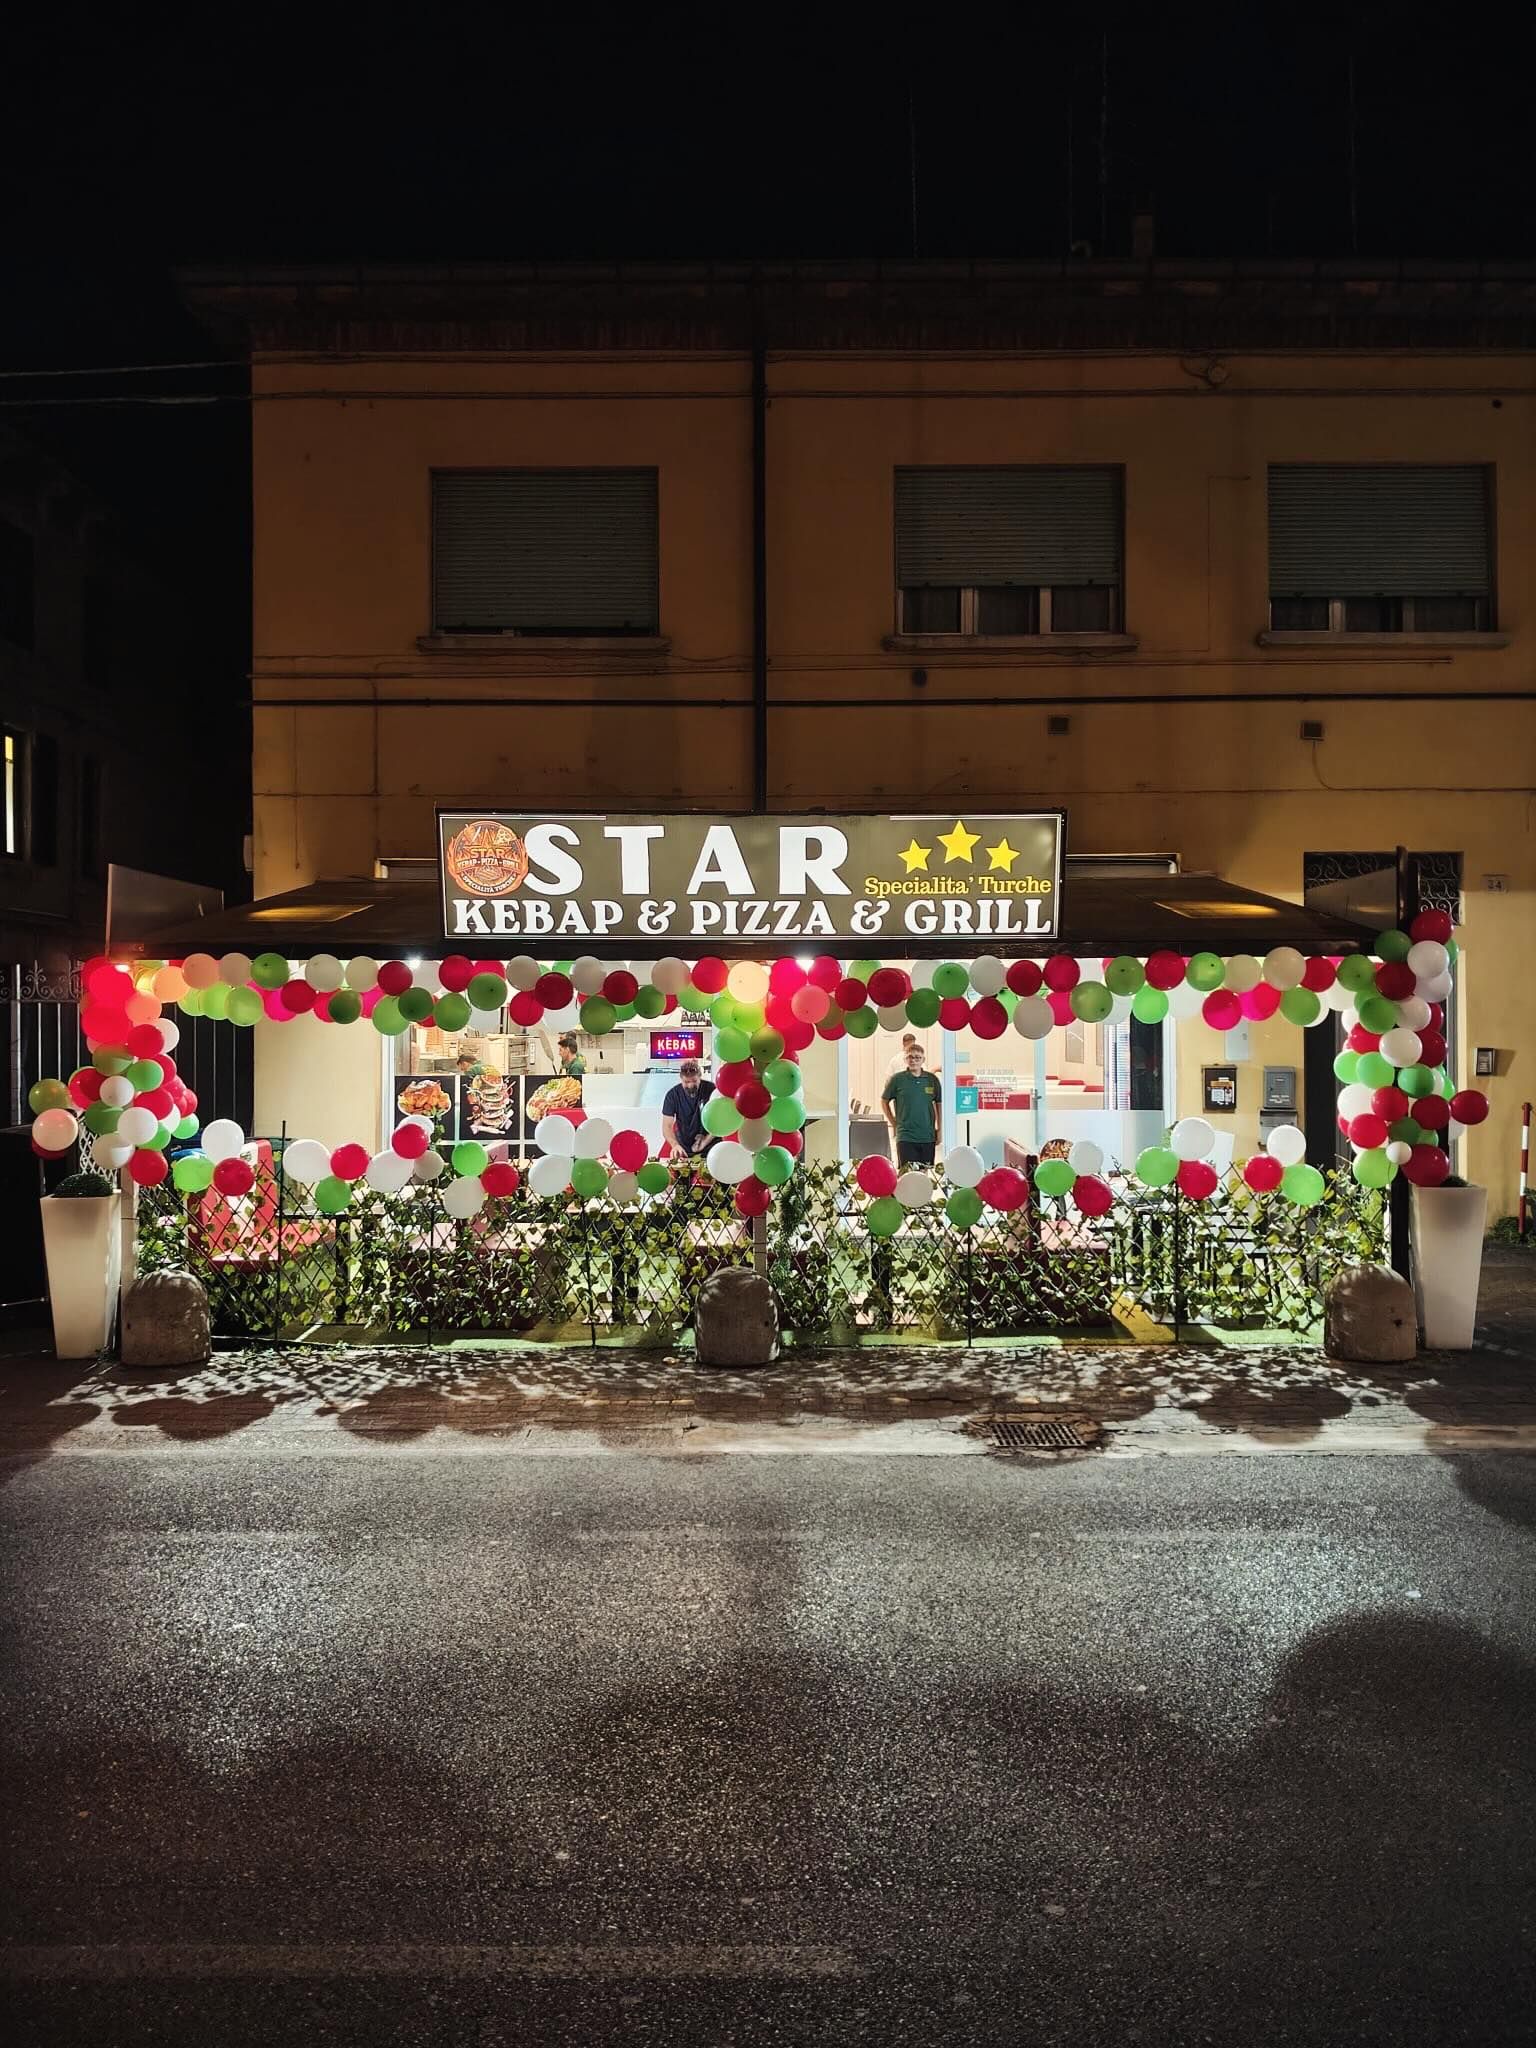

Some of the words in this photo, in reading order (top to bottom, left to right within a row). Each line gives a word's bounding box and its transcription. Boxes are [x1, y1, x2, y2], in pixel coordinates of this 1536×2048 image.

[470, 848, 506, 859] STAR
[481, 857, 499, 866] PIZZA
[524, 823, 852, 896] STAR
[865, 876, 974, 898] Specialita'
[978, 876, 1052, 894] Turche
[452, 900, 624, 934] KEBAP
[637, 900, 677, 935] &
[689, 900, 837, 935] PIZZA
[850, 900, 891, 935] &
[904, 899, 1052, 935] GRILL
[657, 1039, 696, 1051] KEBAB
